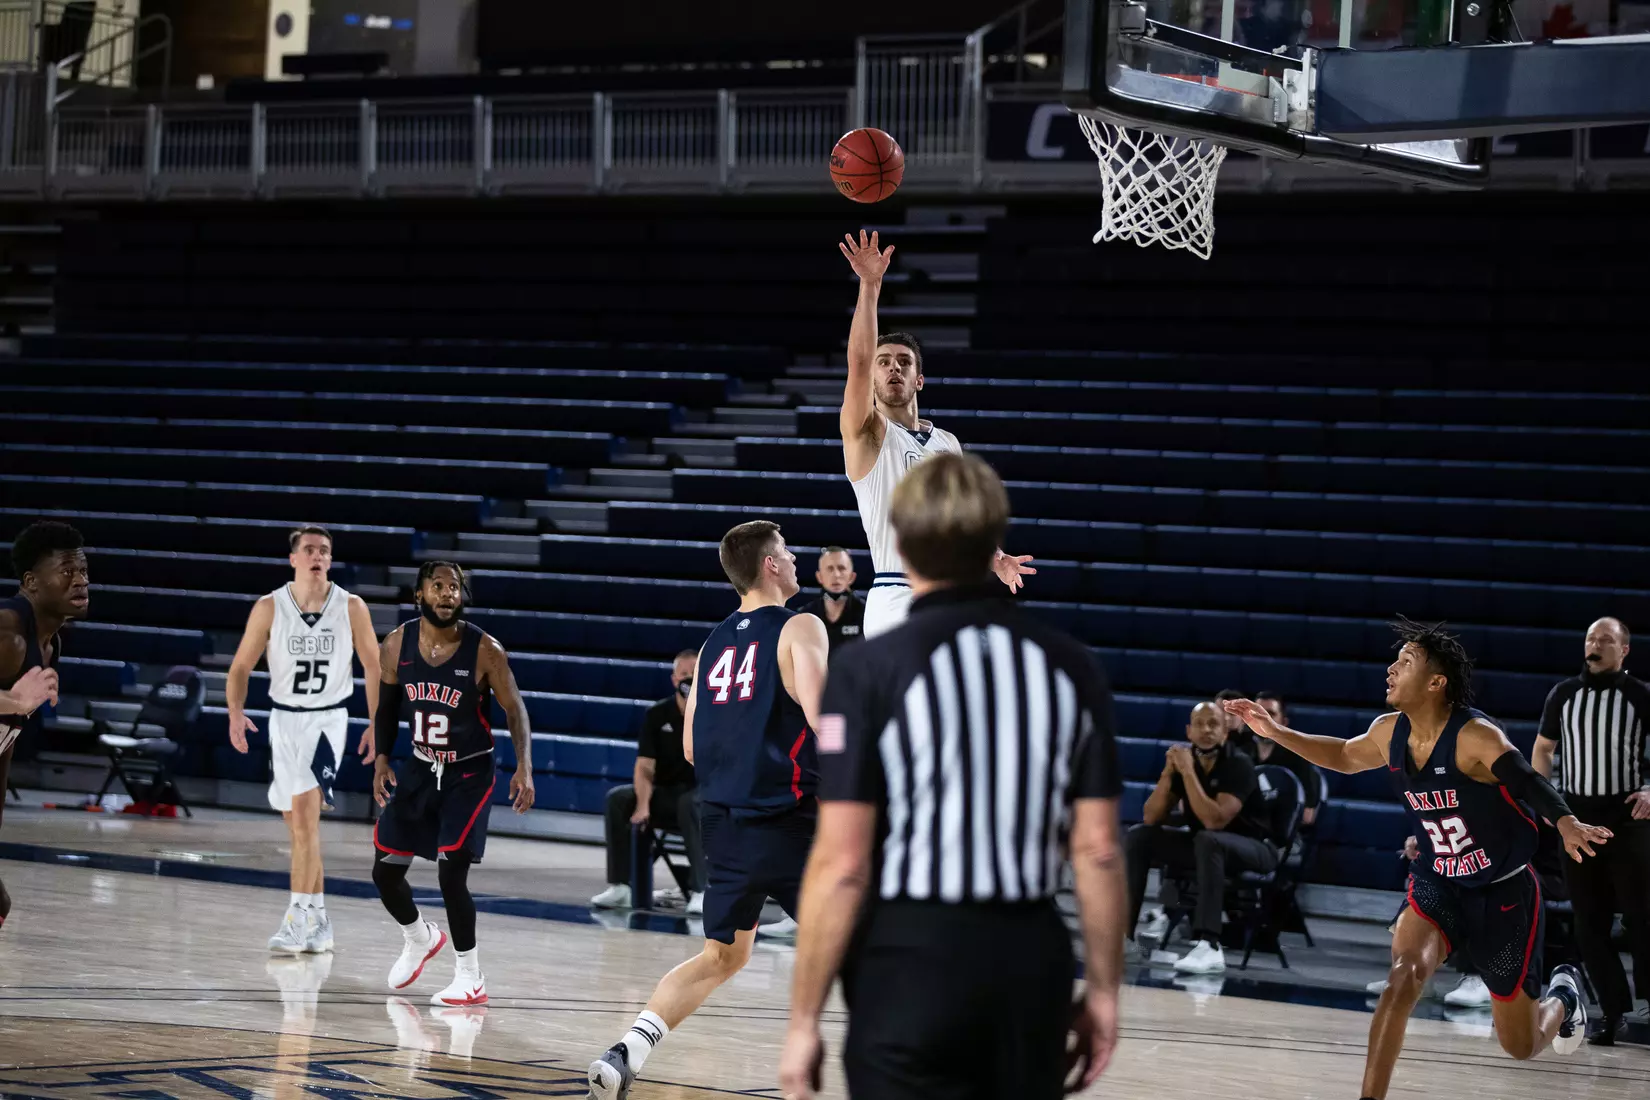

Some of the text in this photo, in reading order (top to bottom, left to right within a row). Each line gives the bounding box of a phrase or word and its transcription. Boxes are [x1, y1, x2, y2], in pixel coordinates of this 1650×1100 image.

[288, 635, 335, 655] CBU
[292, 660, 329, 694] 25
[706, 641, 760, 704] 44
[405, 682, 463, 708] DIXIE
[412, 709, 451, 746] 12
[1404, 789, 1459, 811] DXIE
[1420, 815, 1476, 857] 22
[1432, 848, 1492, 877] STATE
